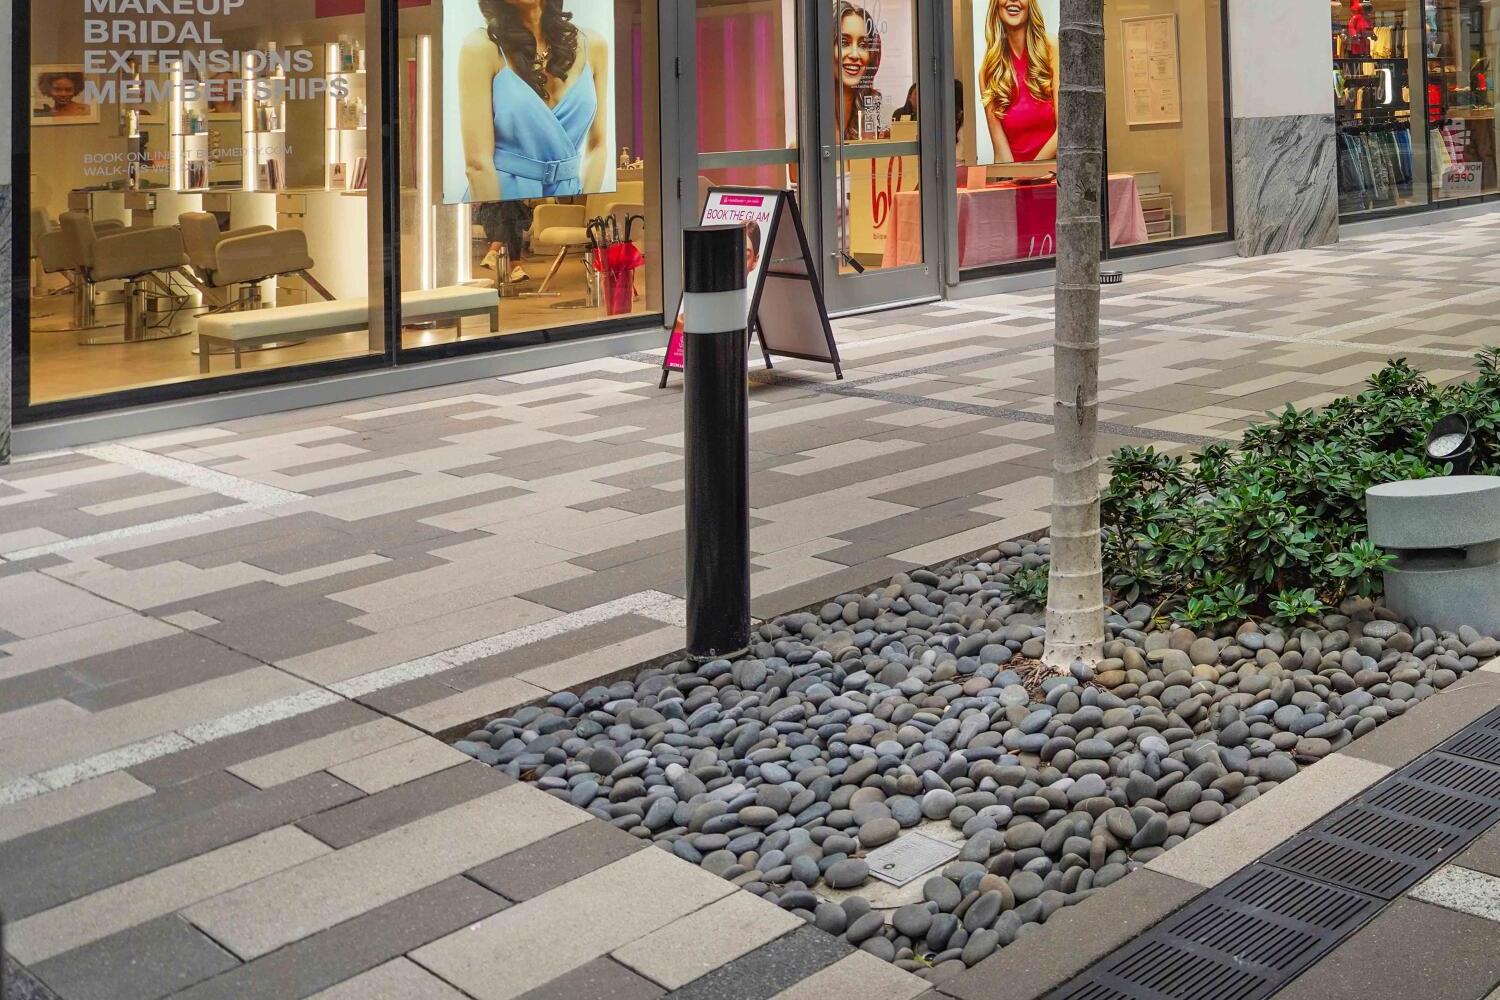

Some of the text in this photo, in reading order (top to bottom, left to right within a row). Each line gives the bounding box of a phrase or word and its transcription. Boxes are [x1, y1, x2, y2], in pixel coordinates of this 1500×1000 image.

[84, 19, 223, 44] BRIDAL
[84, 50, 313, 73] EXTENSIONS
[84, 78, 349, 104] MEMBERSHIPS
[84, 152, 123, 164] BOOK
[706, 209, 729, 220] BOOK
[729, 210, 746, 221] THE
